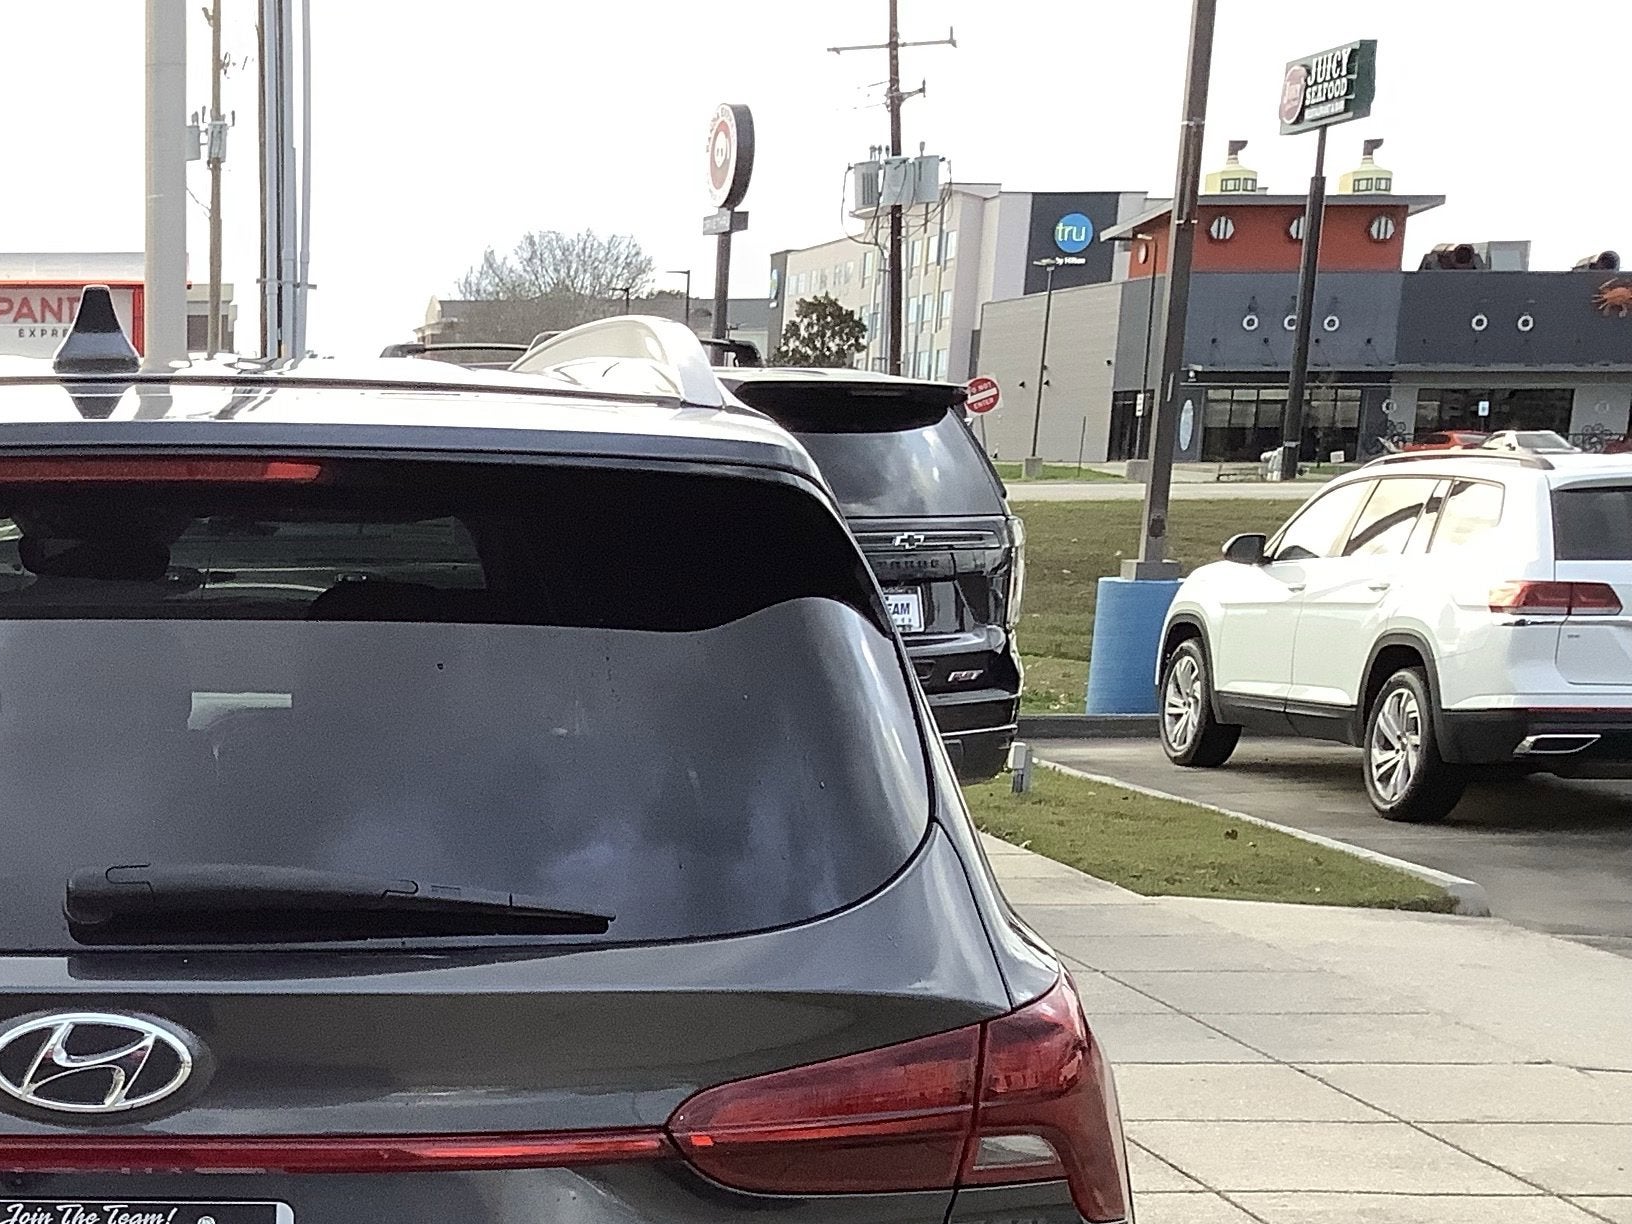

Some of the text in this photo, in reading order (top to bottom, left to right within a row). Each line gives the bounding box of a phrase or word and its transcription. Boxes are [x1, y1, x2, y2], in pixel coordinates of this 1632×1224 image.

[1306, 47, 1352, 86] JUICY
[1304, 77, 1348, 106] SEAFOOD
[1055, 222, 1086, 242] tru
